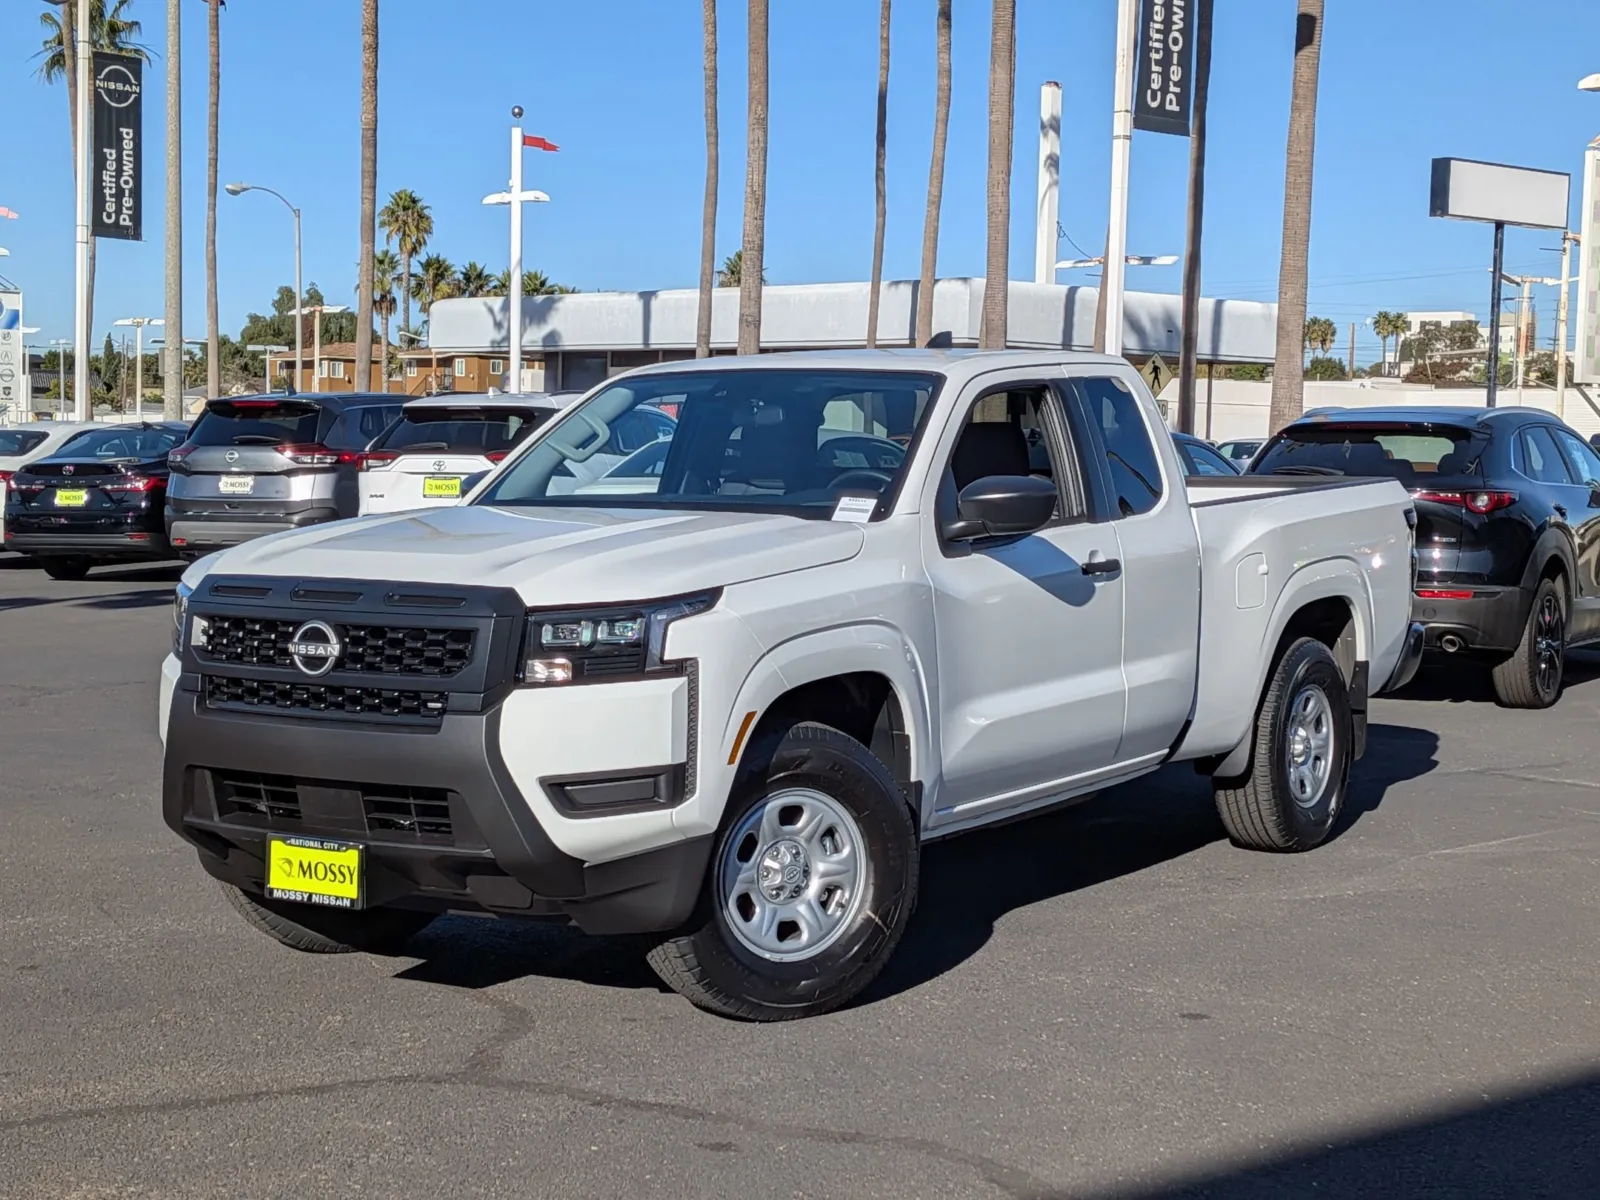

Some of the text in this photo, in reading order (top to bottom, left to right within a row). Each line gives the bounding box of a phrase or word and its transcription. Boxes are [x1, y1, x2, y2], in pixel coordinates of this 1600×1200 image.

[95, 79, 140, 93] NISSAN
[119, 127, 134, 227] Pre-Owned
[102, 148, 117, 224] Certified
[434, 483, 459, 492] MOSSY
[287, 643, 339, 656] NISSAN
[290, 838, 339, 850] NATIONAL CITY
[298, 859, 356, 885] MOSSY
[272, 888, 351, 907] MOSSY NISSAN
